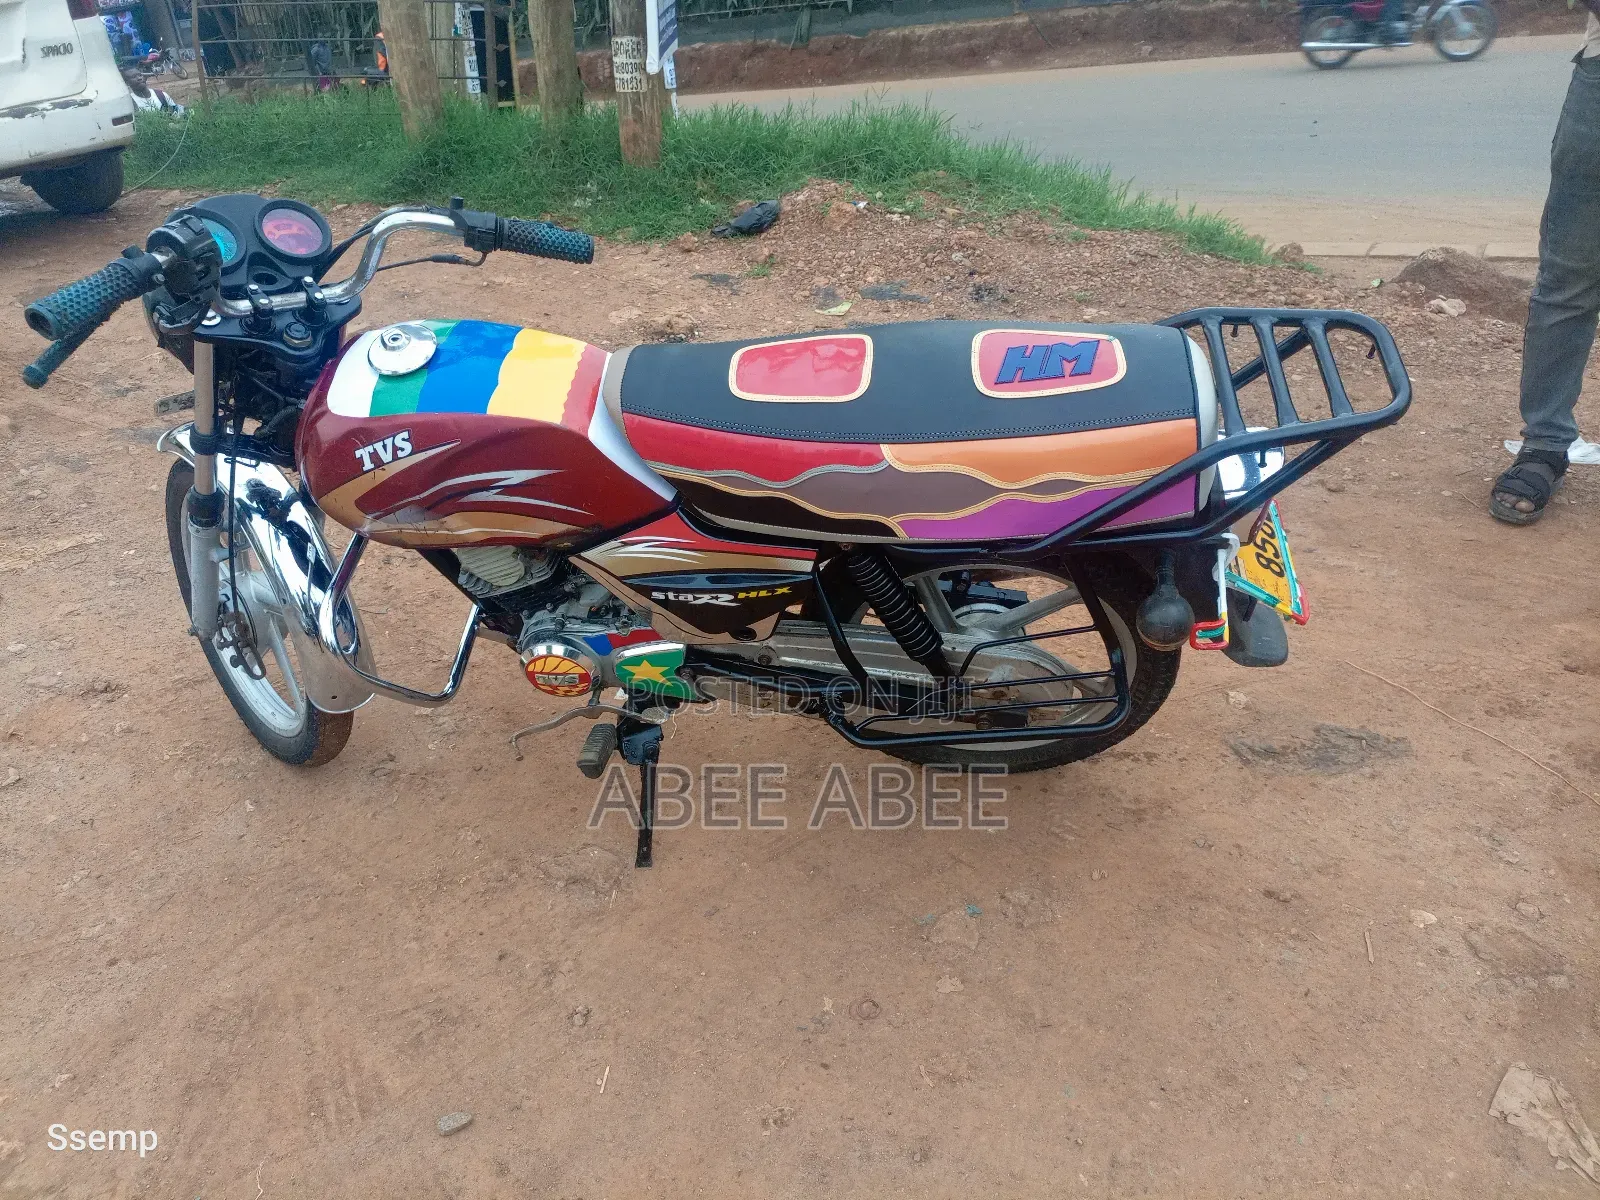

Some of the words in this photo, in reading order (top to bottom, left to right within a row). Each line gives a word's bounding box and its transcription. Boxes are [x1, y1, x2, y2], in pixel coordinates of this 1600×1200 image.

[40, 42, 74, 58] SPACIO
[994, 340, 1100, 385] HM
[354, 430, 413, 472] TVS
[736, 586, 793, 599] HLX
